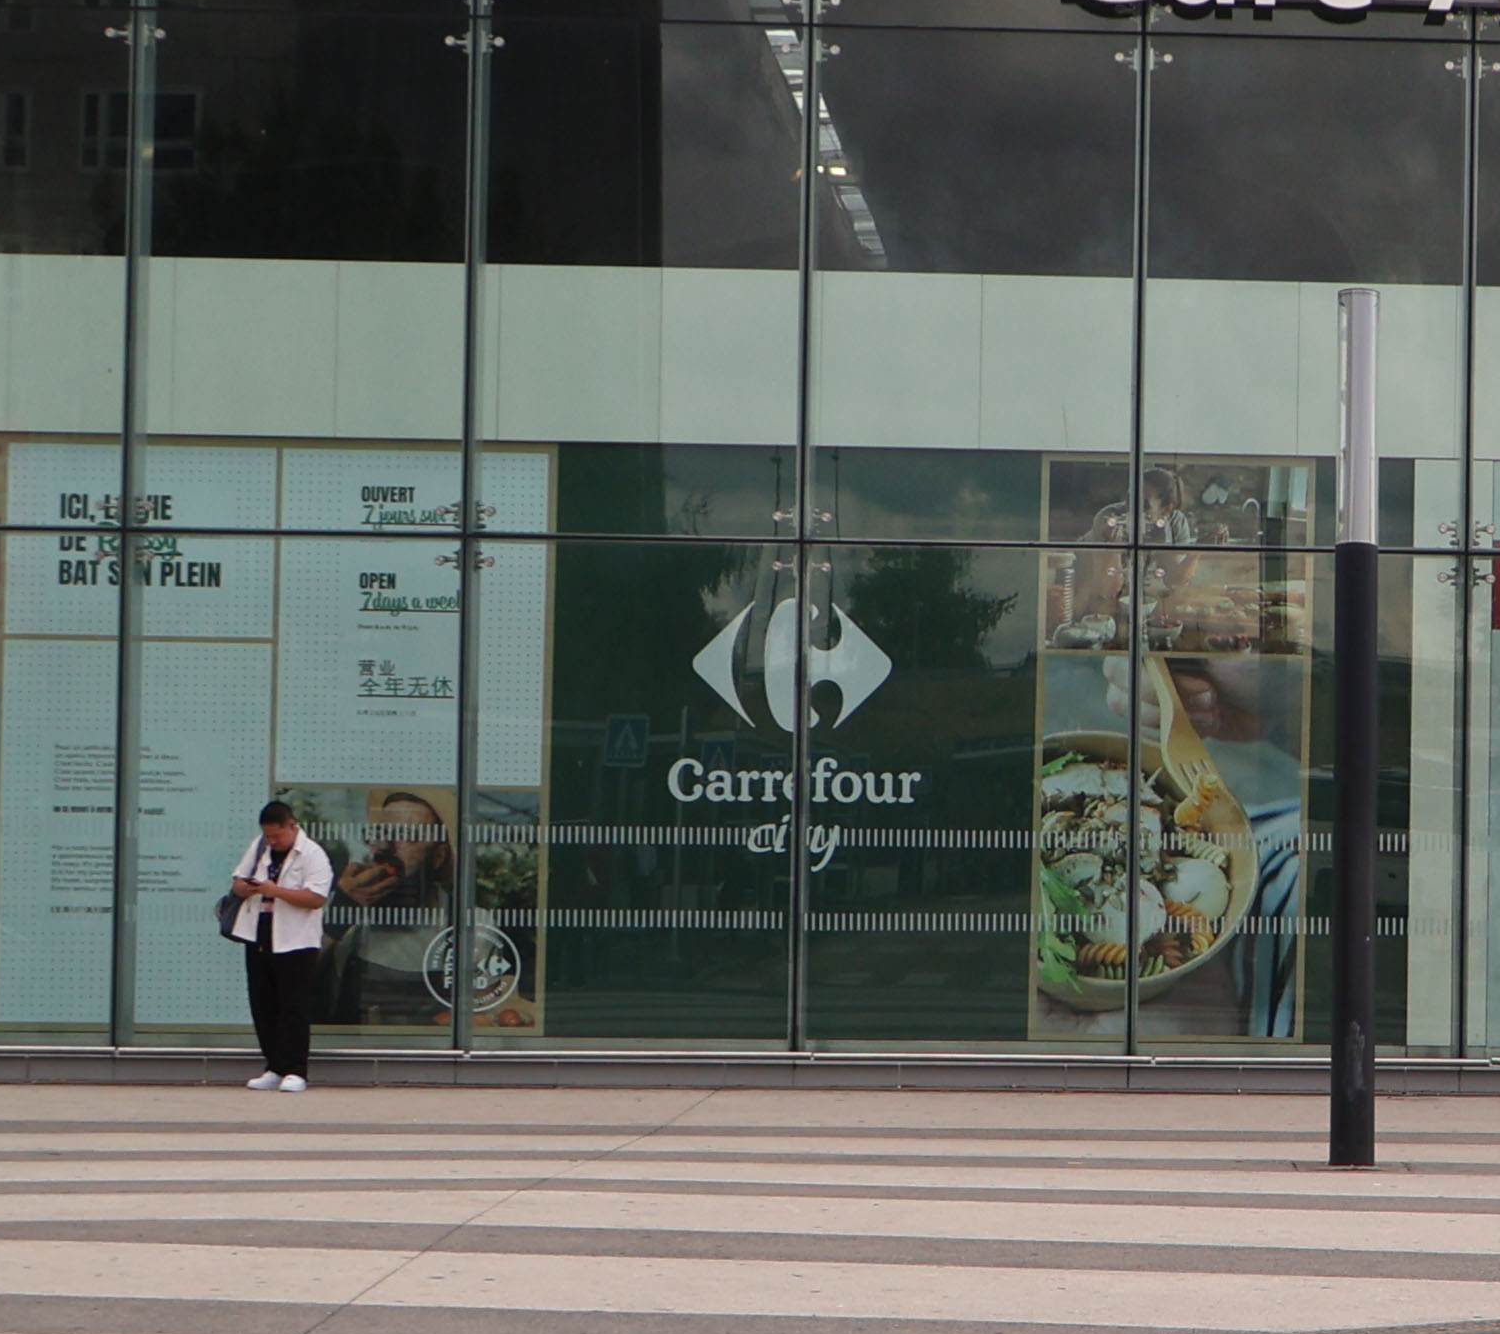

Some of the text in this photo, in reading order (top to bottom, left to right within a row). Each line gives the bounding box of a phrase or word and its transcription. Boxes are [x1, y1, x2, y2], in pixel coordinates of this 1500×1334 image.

[60, 493, 96, 522] ICI,
[361, 486, 415, 503] OUVERT
[59, 560, 221, 587] BAT SN PLEIN
[359, 572, 396, 589] OPEN
[747, 814, 841, 872] ciy
